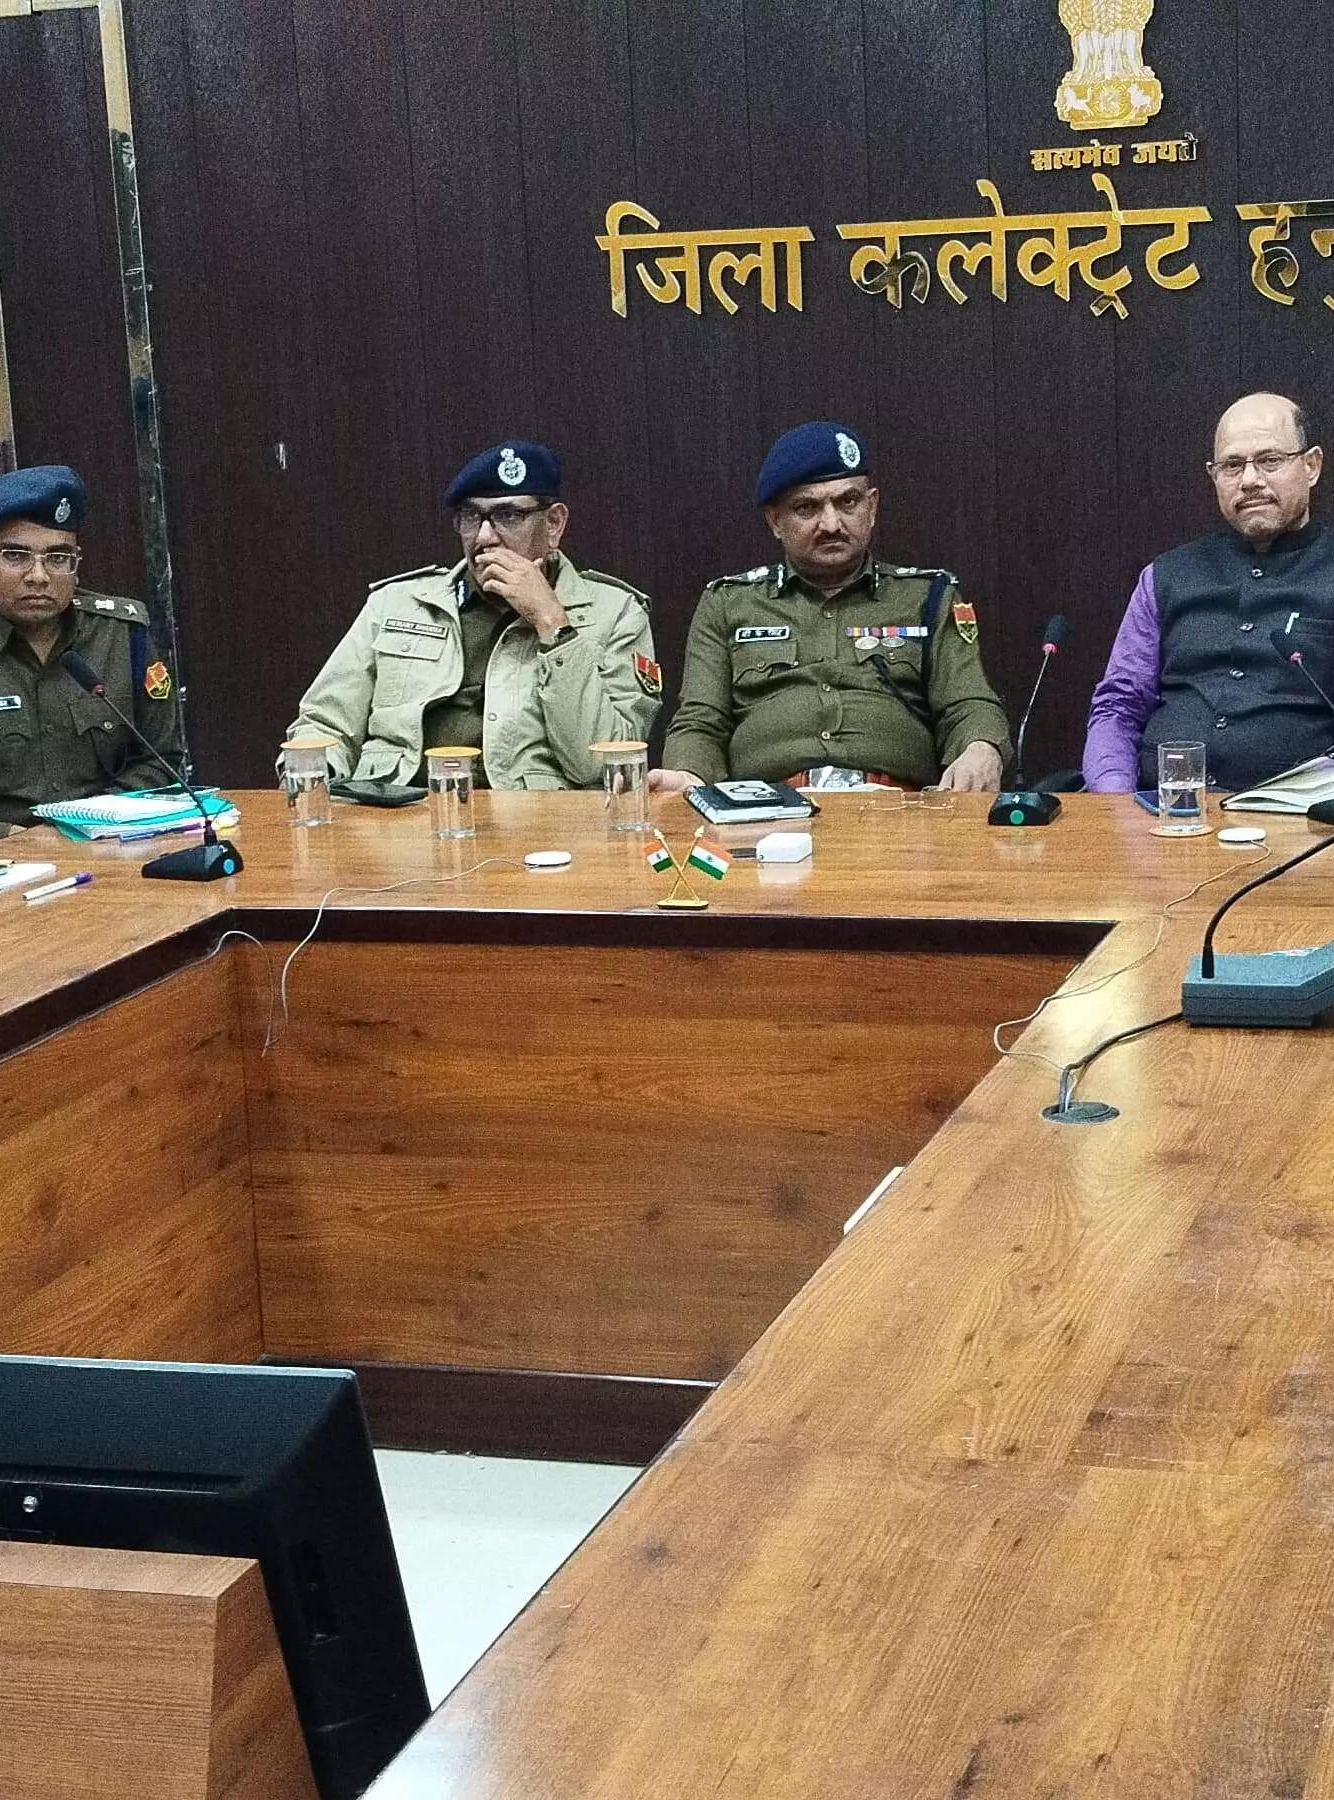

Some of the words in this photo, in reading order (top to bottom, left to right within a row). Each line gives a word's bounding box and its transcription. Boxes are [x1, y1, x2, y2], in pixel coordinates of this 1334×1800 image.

[1030, 139, 1122, 171] सत्यमेव
[1131, 132, 1198, 164] जयते
[595, 201, 815, 318] जिला
[835, 172, 1213, 320] कलेक्ट्रेट
